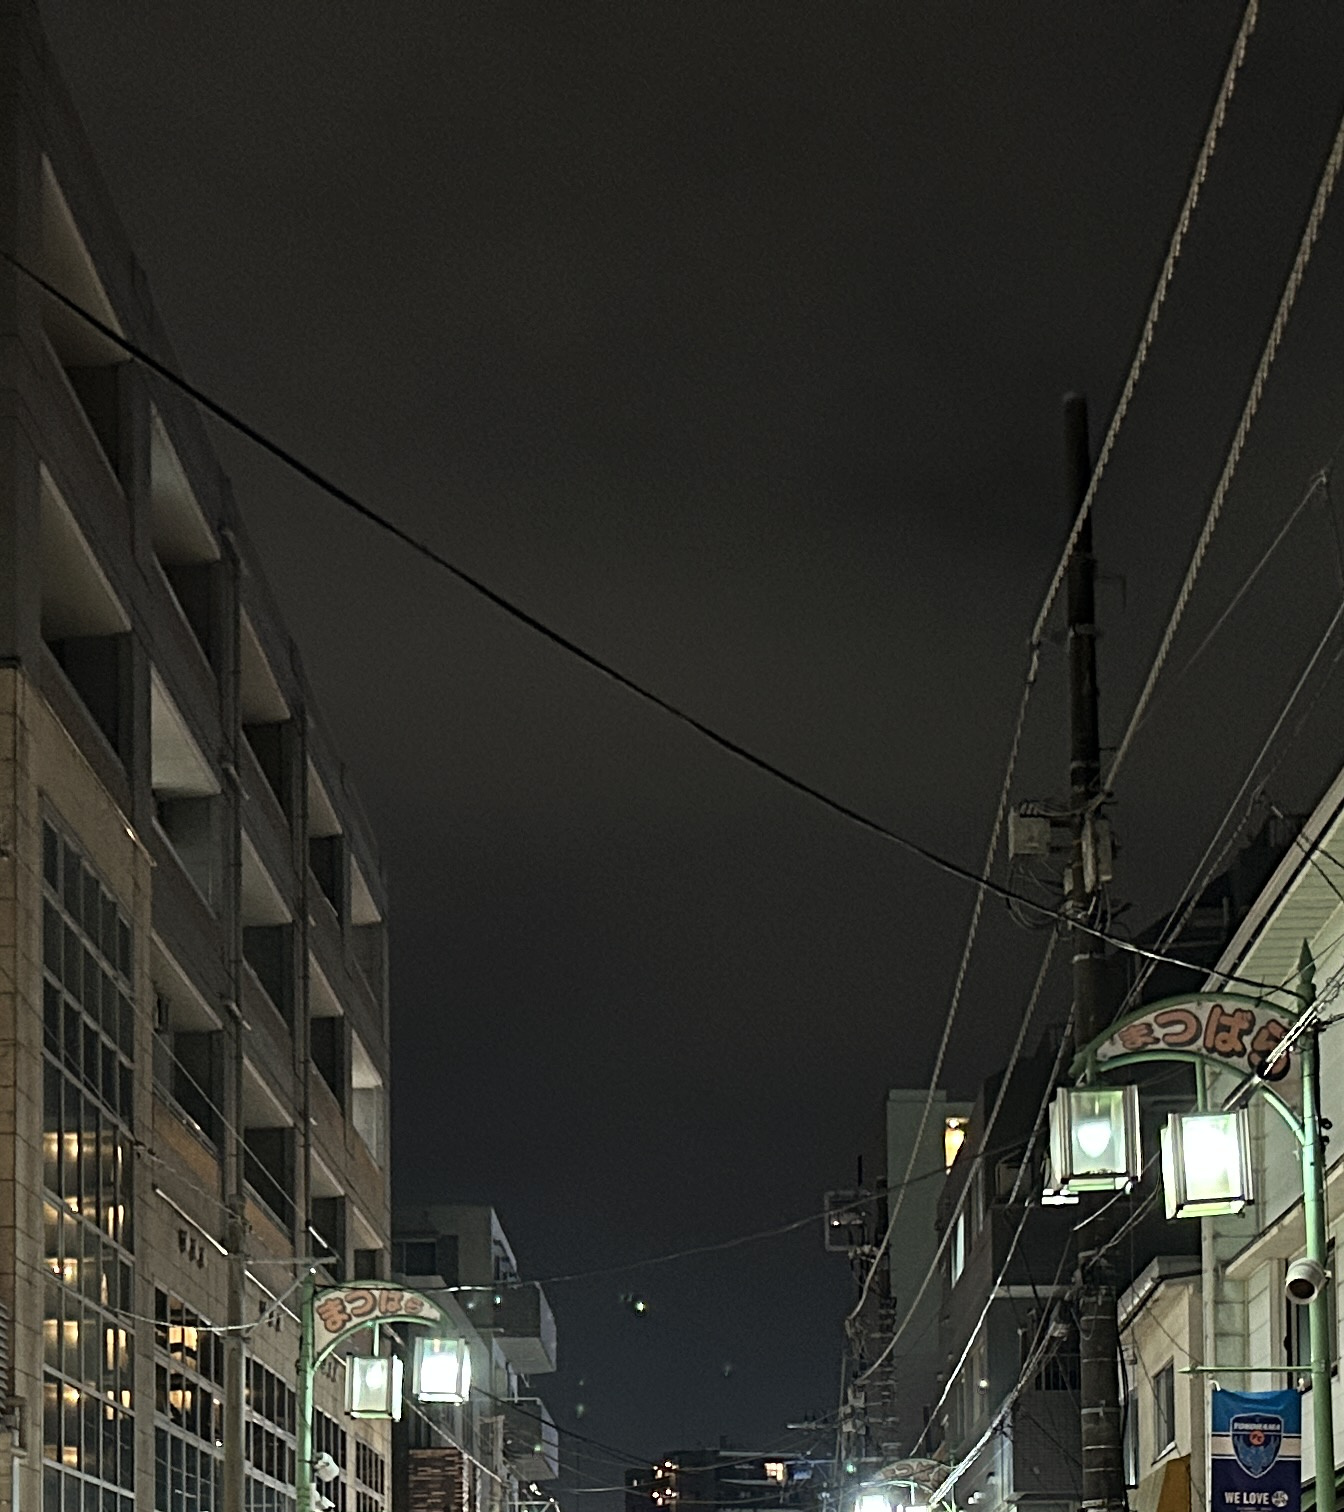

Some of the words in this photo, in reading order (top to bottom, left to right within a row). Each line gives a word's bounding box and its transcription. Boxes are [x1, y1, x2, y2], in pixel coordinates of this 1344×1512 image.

[1119, 1004, 1291, 1082] まつばら
[316, 1289, 424, 1333] まつばら
[1224, 1491, 1241, 1504] WE
[1243, 1492, 1270, 1505] LOVE
